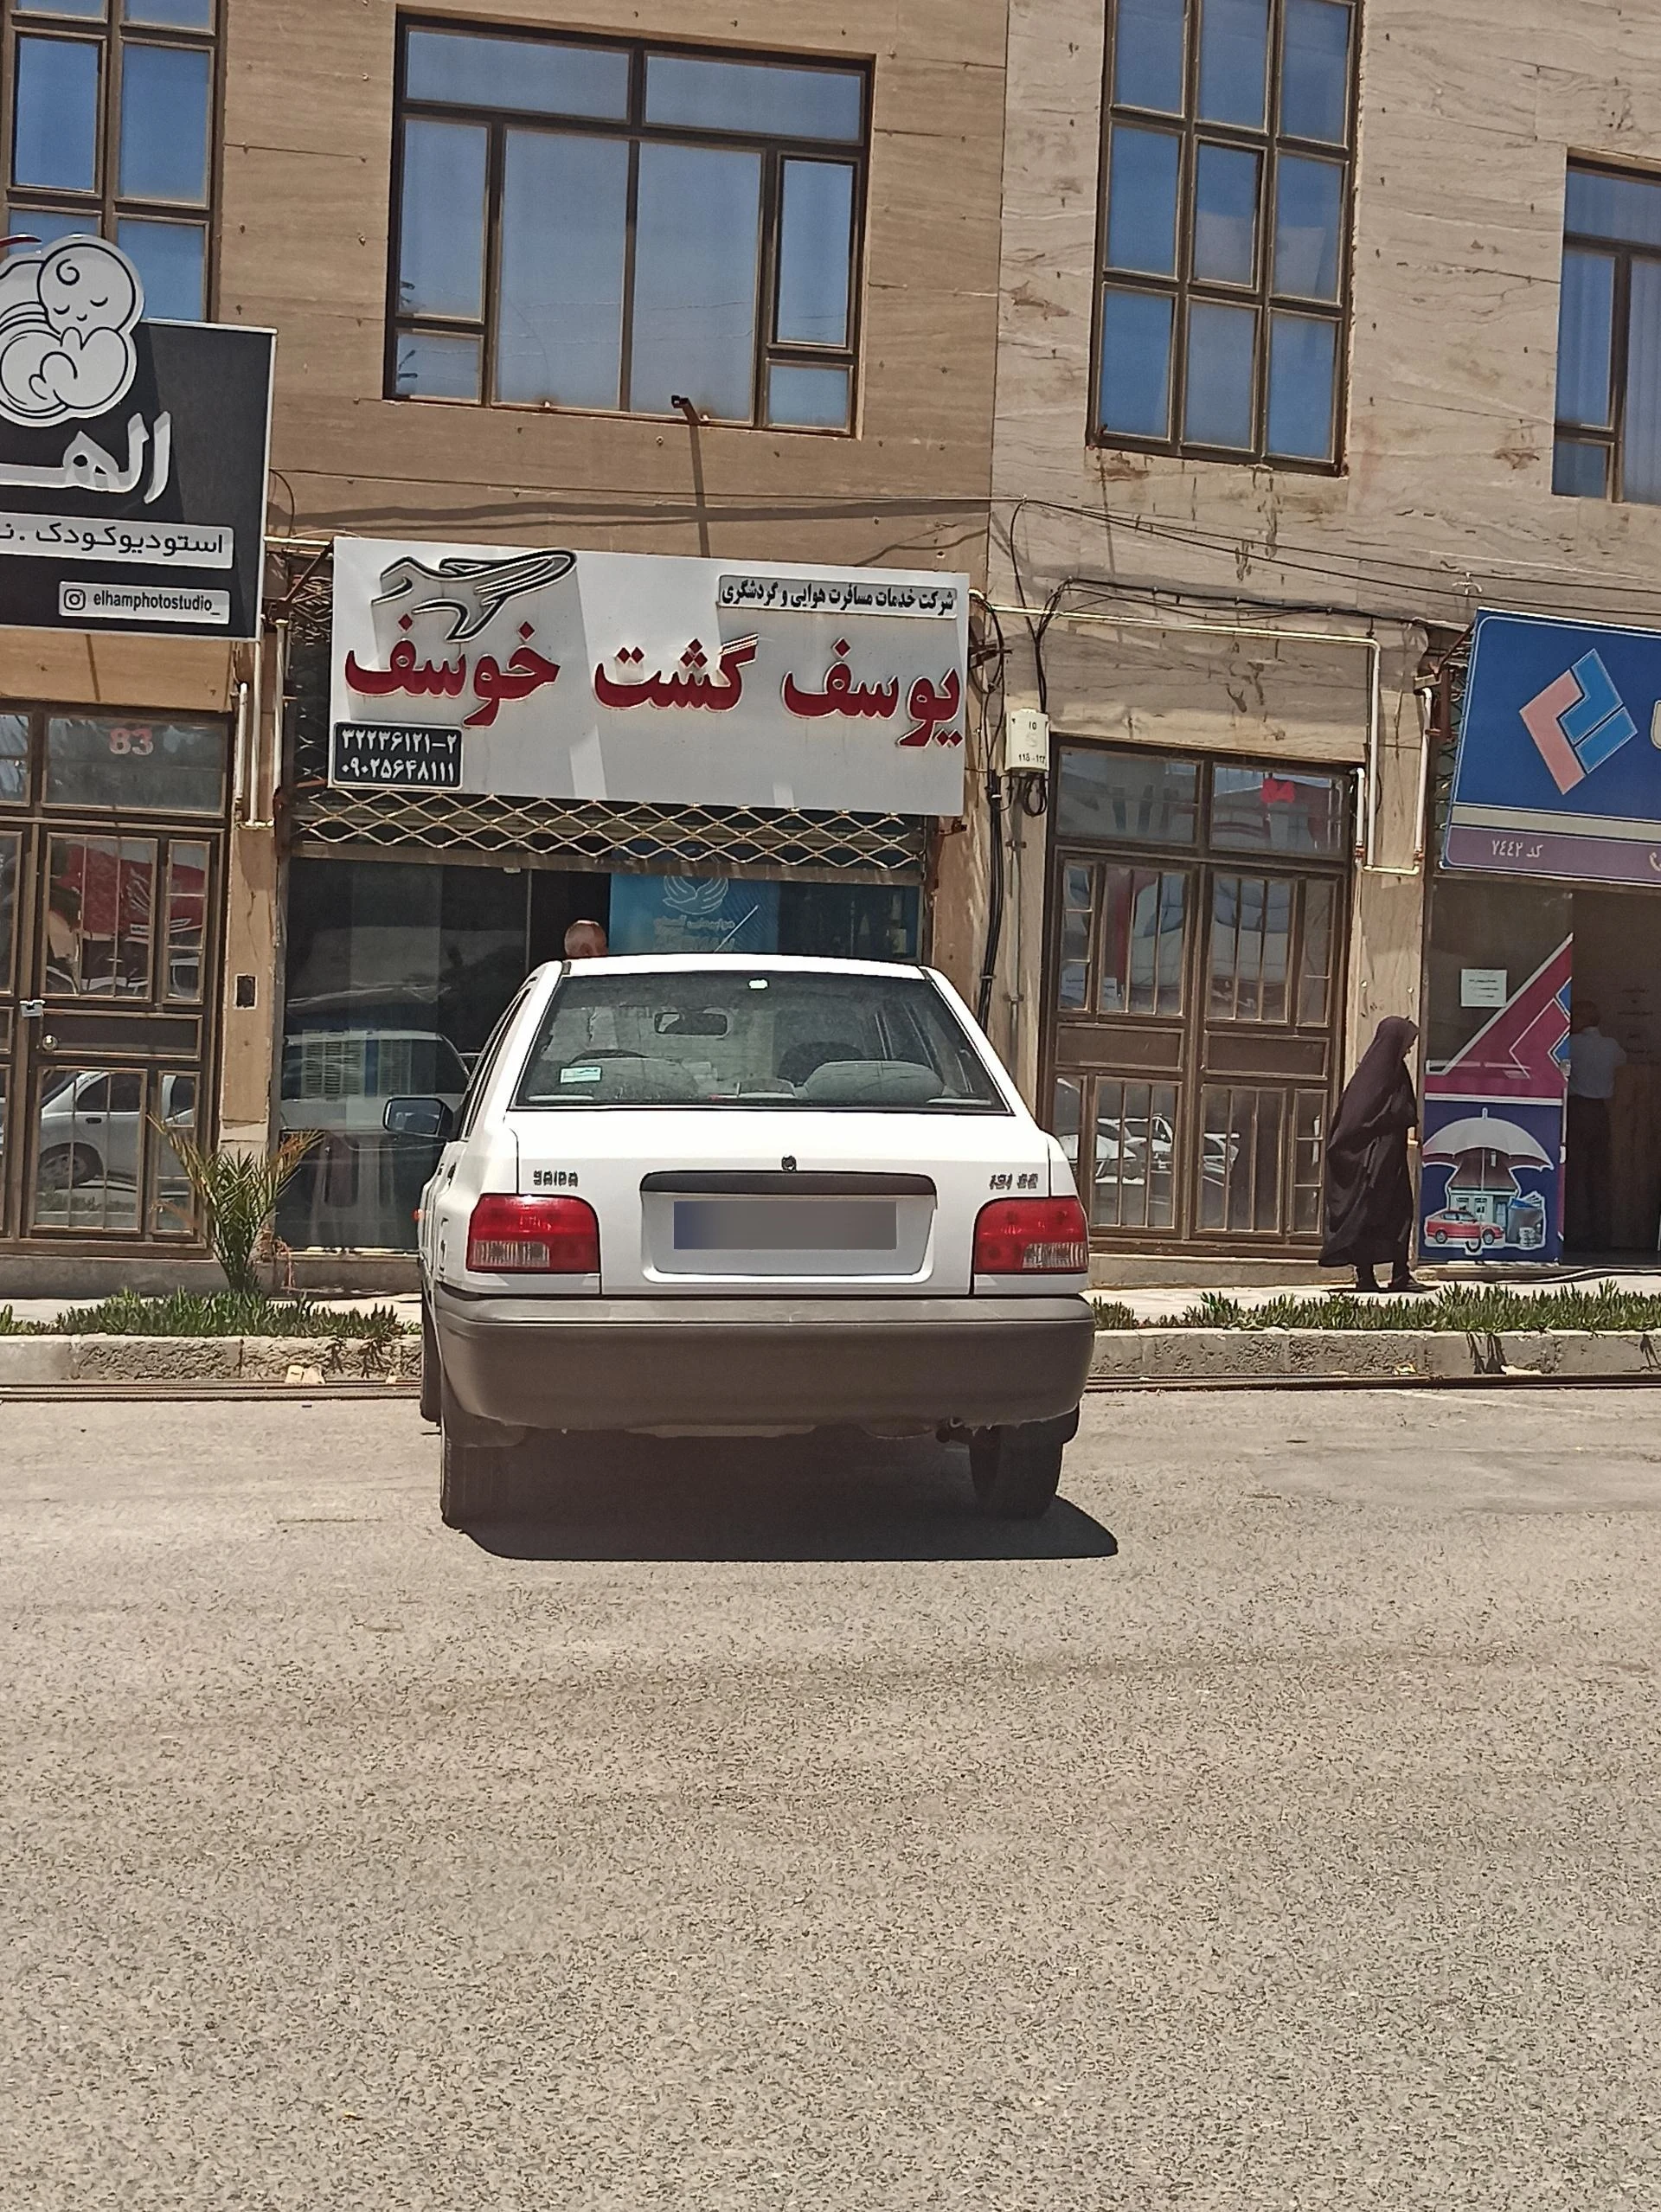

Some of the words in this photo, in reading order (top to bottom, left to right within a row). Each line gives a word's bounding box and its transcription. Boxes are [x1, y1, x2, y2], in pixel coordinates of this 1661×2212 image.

[0, 411, 171, 504] اله
[721, 579, 779, 606] گردشگری
[780, 590, 788, 607] و
[790, 583, 825, 609] هوایی
[829, 583, 873, 611] مسافرت
[875, 587, 915, 608] خدمات
[919, 590, 954, 616] شرکت
[344, 612, 561, 728] خوسف
[593, 633, 759, 713] گشت
[782, 637, 963, 747] یوسف
[109, 728, 154, 755] 83
[1525, 843, 1544, 858] کد
